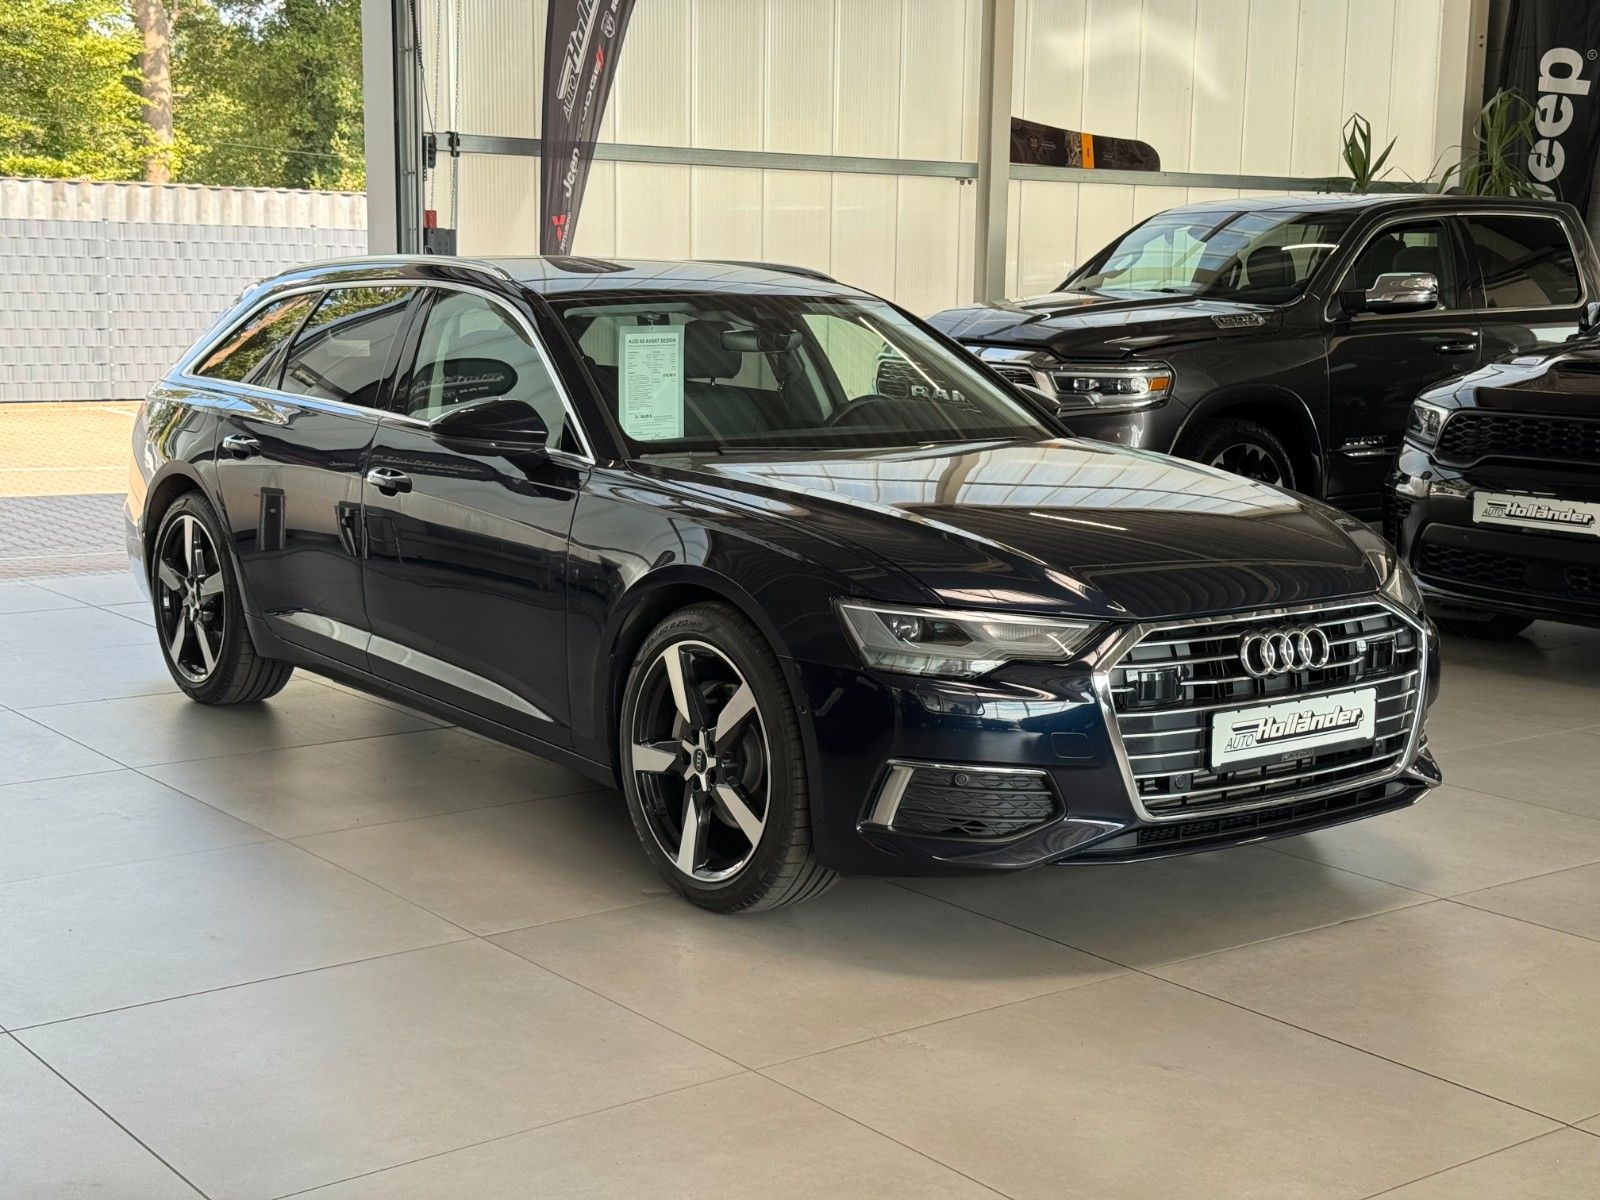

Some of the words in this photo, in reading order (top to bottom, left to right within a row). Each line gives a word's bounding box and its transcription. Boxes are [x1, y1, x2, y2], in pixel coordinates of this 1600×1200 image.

[562, 73, 577, 119] AUTO
[1482, 507, 1505, 517] AUTO
[1501, 501, 1594, 525] Holländer
[1224, 734, 1254, 750] AUTO
[1248, 704, 1363, 743] Holländer
